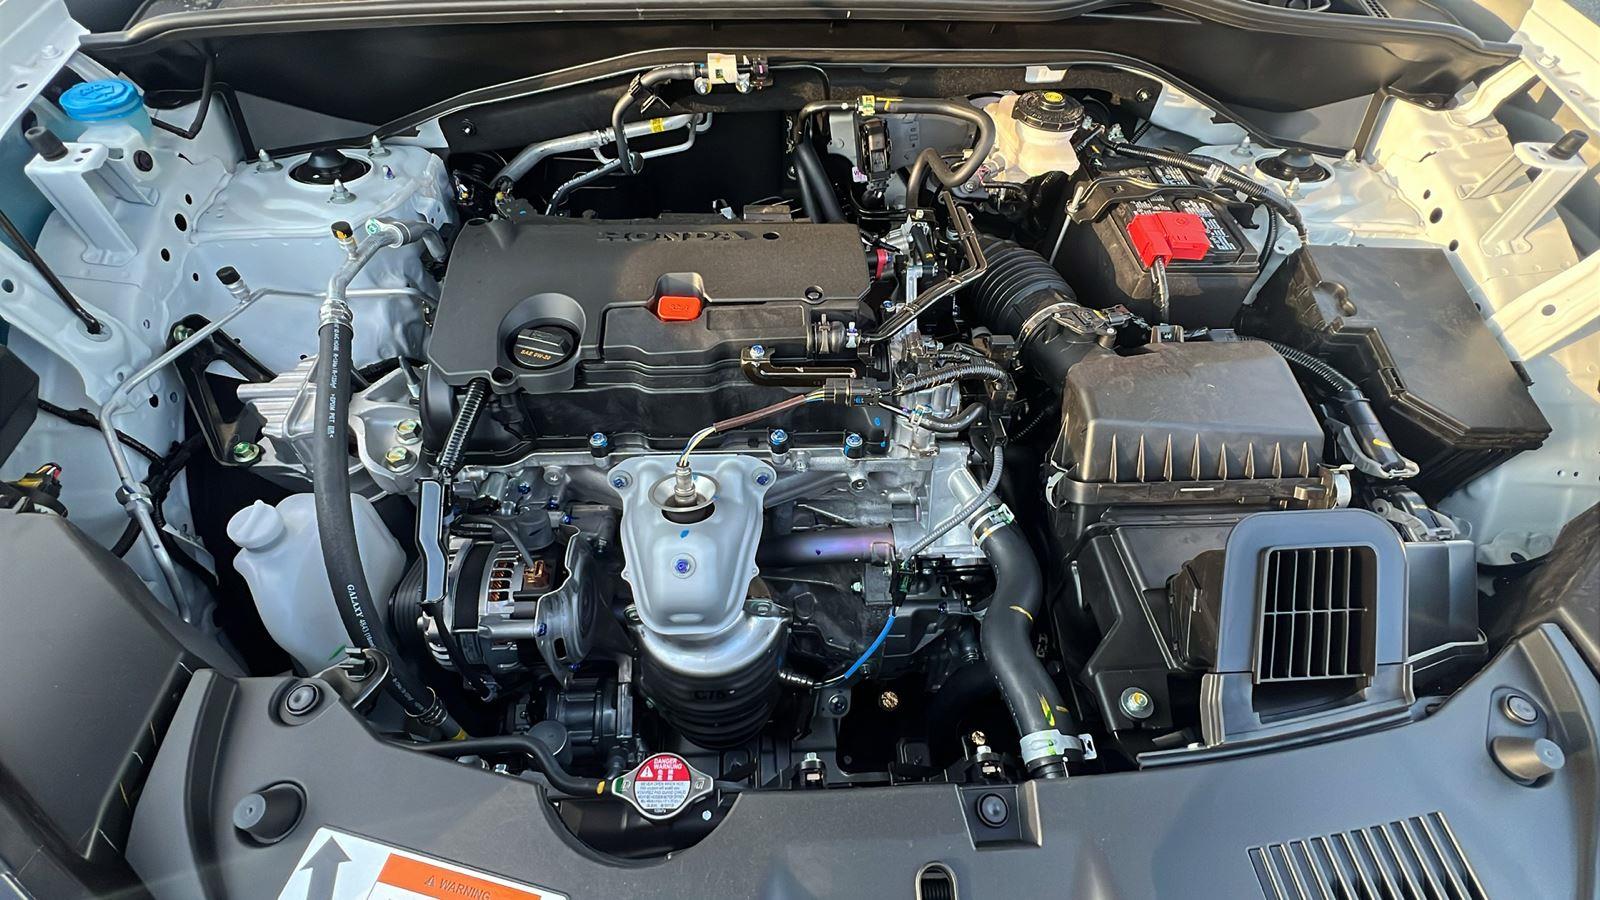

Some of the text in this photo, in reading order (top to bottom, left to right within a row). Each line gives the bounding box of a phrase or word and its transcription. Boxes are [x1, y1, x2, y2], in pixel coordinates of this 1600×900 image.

[597, 231, 751, 242] HONDA
[347, 584, 364, 617] GALAXY
[439, 878, 491, 900] WARNING
